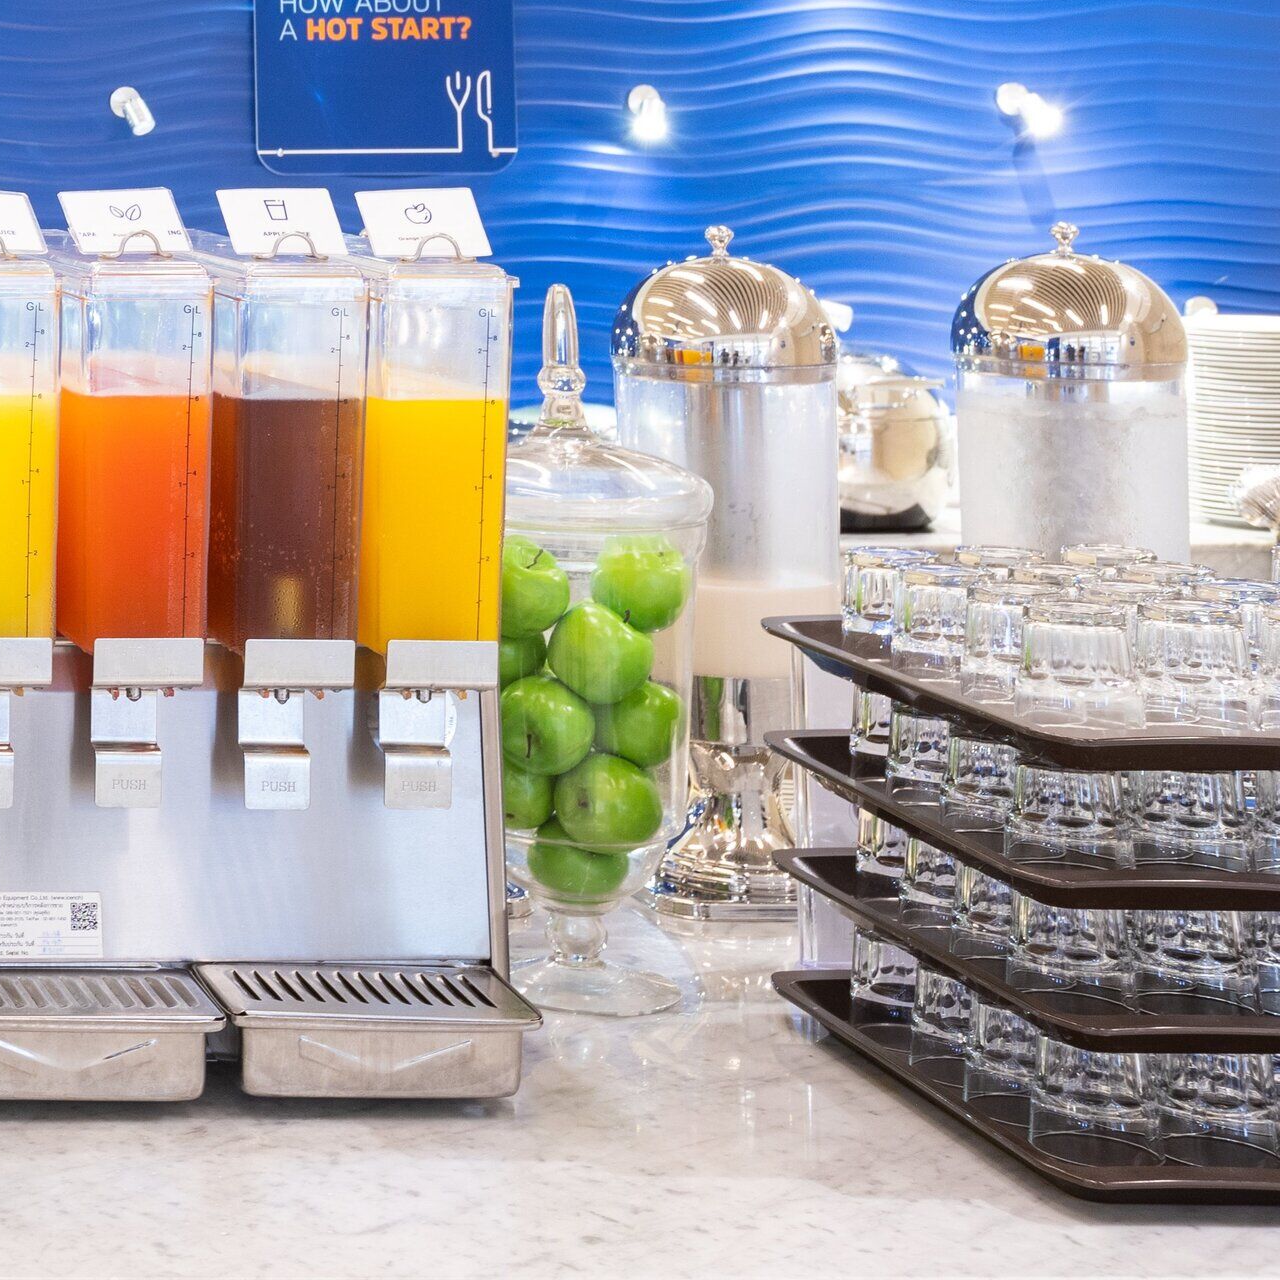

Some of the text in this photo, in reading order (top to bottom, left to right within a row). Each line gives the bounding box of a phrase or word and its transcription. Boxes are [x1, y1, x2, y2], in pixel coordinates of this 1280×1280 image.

[279, 16, 472, 41] A HOT START?
[26, 301, 44, 311] G L
[183, 304, 201, 314] G L
[331, 307, 349, 316] G L
[478, 308, 496, 317] G L
[111, 779, 147, 790] PUSH
[261, 781, 296, 792] PUSH
[401, 780, 436, 792] PUSH
